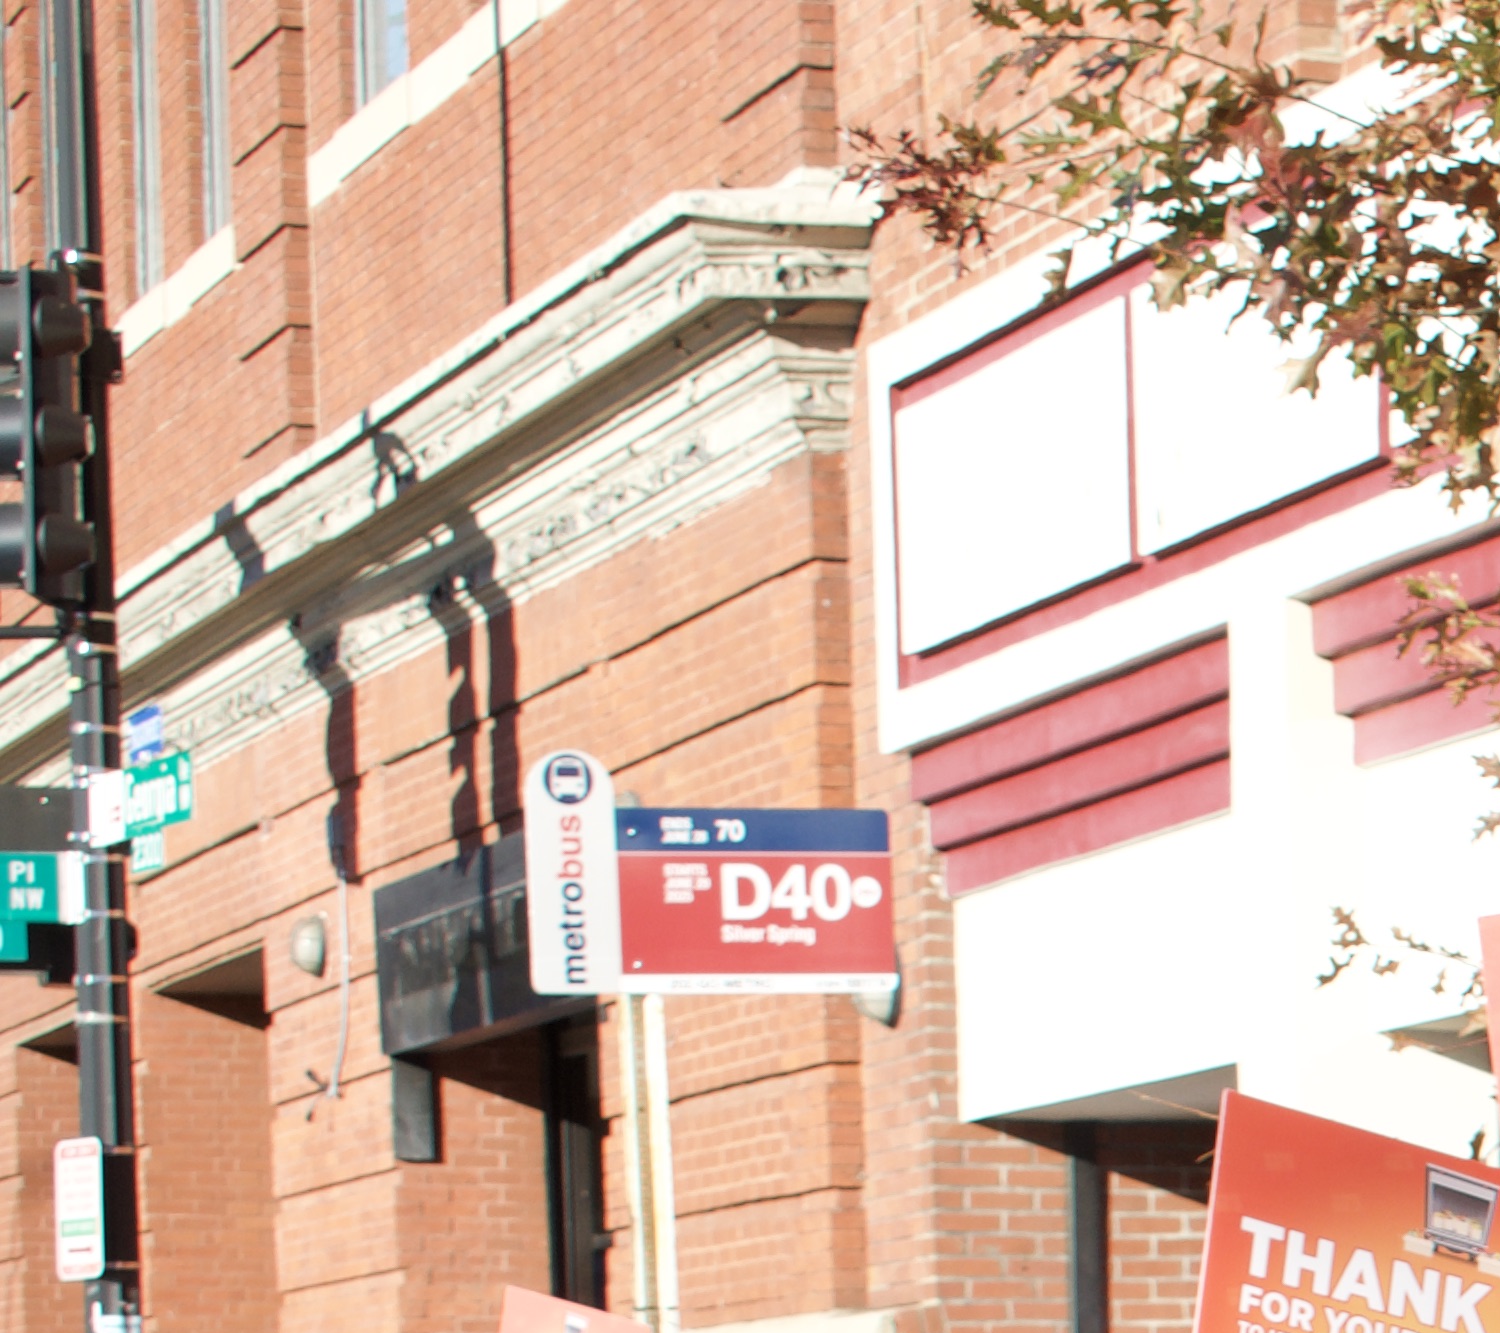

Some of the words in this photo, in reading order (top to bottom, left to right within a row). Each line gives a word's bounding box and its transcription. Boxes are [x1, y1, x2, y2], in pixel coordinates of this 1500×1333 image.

[713, 818, 747, 844] 70
[7, 888, 45, 911] NW
[556, 814, 588, 986] metrobus
[718, 861, 853, 923] D40
[720, 924, 766, 945] Silver
[766, 924, 817, 948] Spring
[1236, 1283, 1314, 1333] FOR
